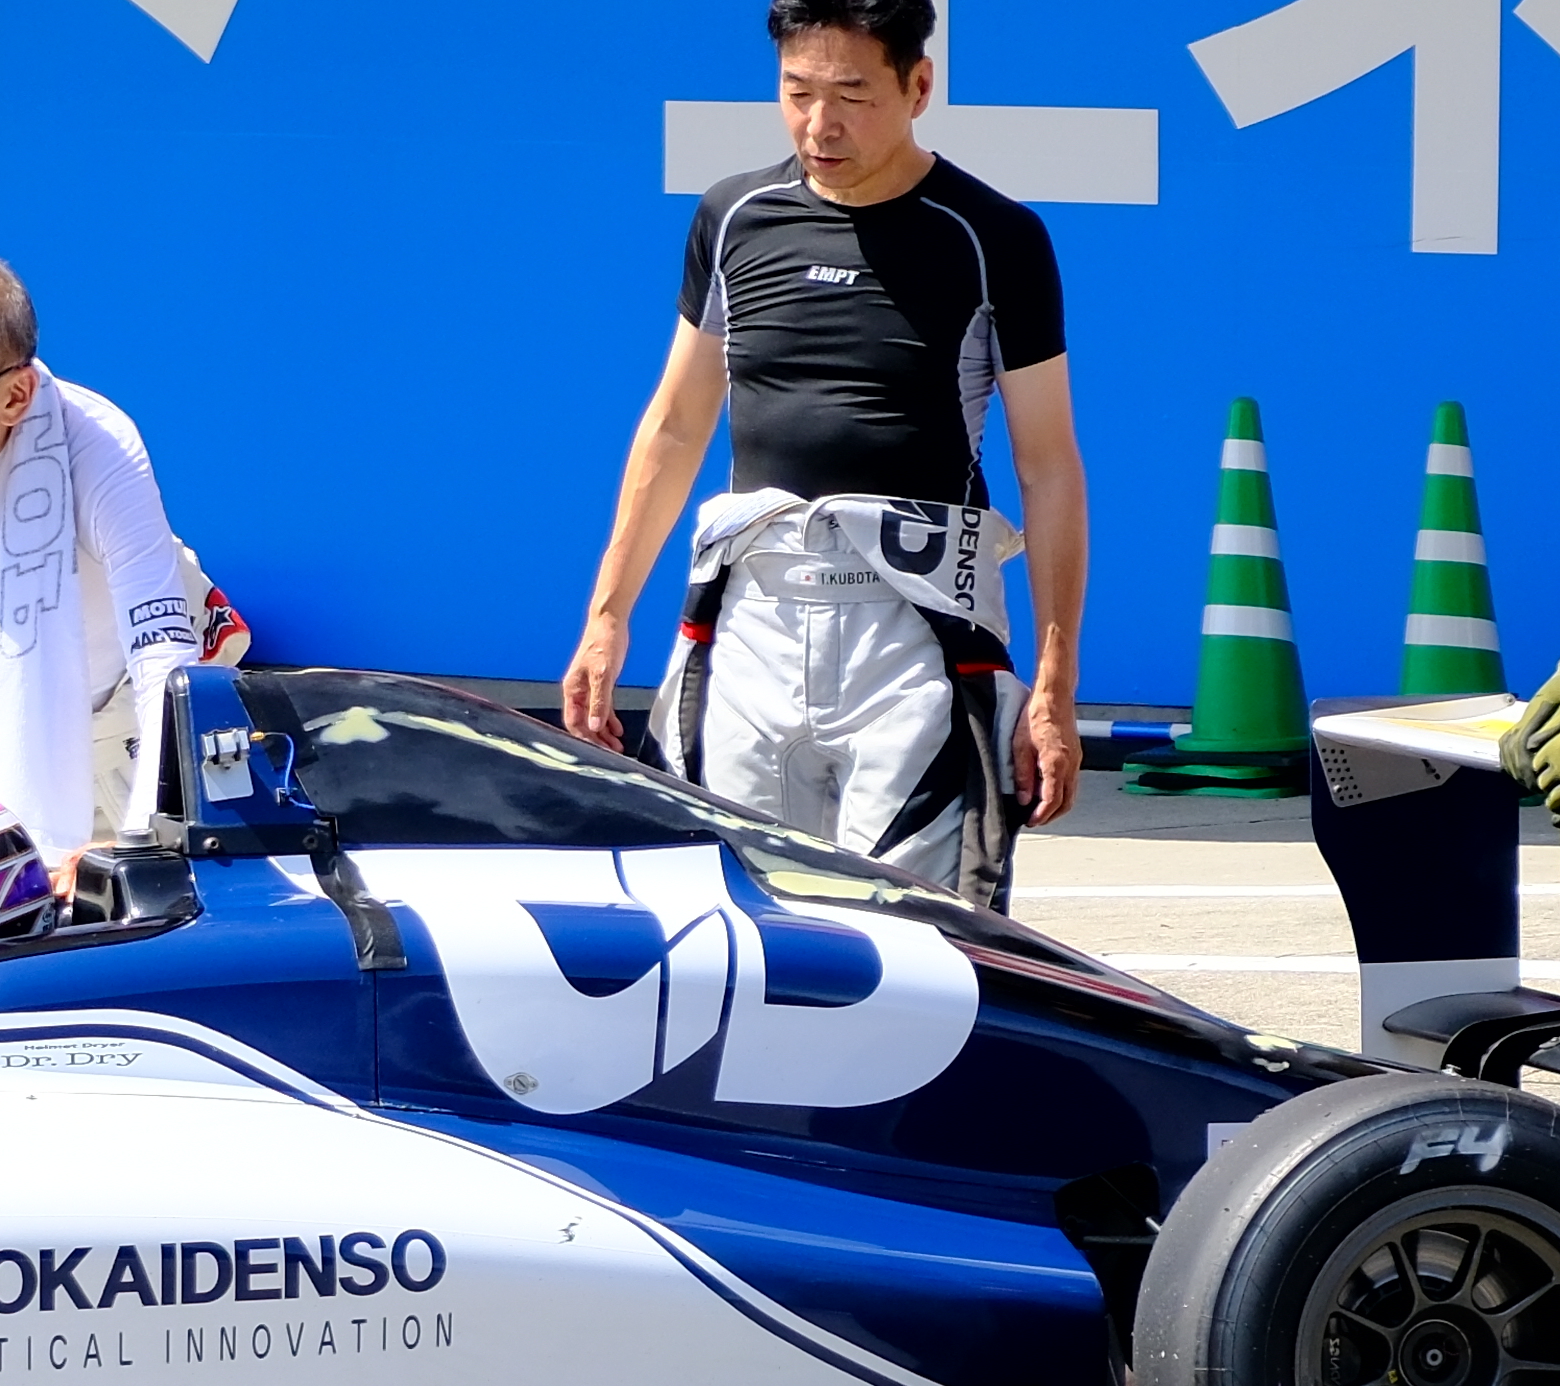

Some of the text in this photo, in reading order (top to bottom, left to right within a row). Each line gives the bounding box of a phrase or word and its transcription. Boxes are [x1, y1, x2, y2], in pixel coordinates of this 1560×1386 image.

[806, 265, 860, 286] EMPT
[0, 1051, 143, 1068] Dr. Dry
[1399, 1123, 1507, 1176] F4
[164, 1312, 454, 1365] INNOVATION
